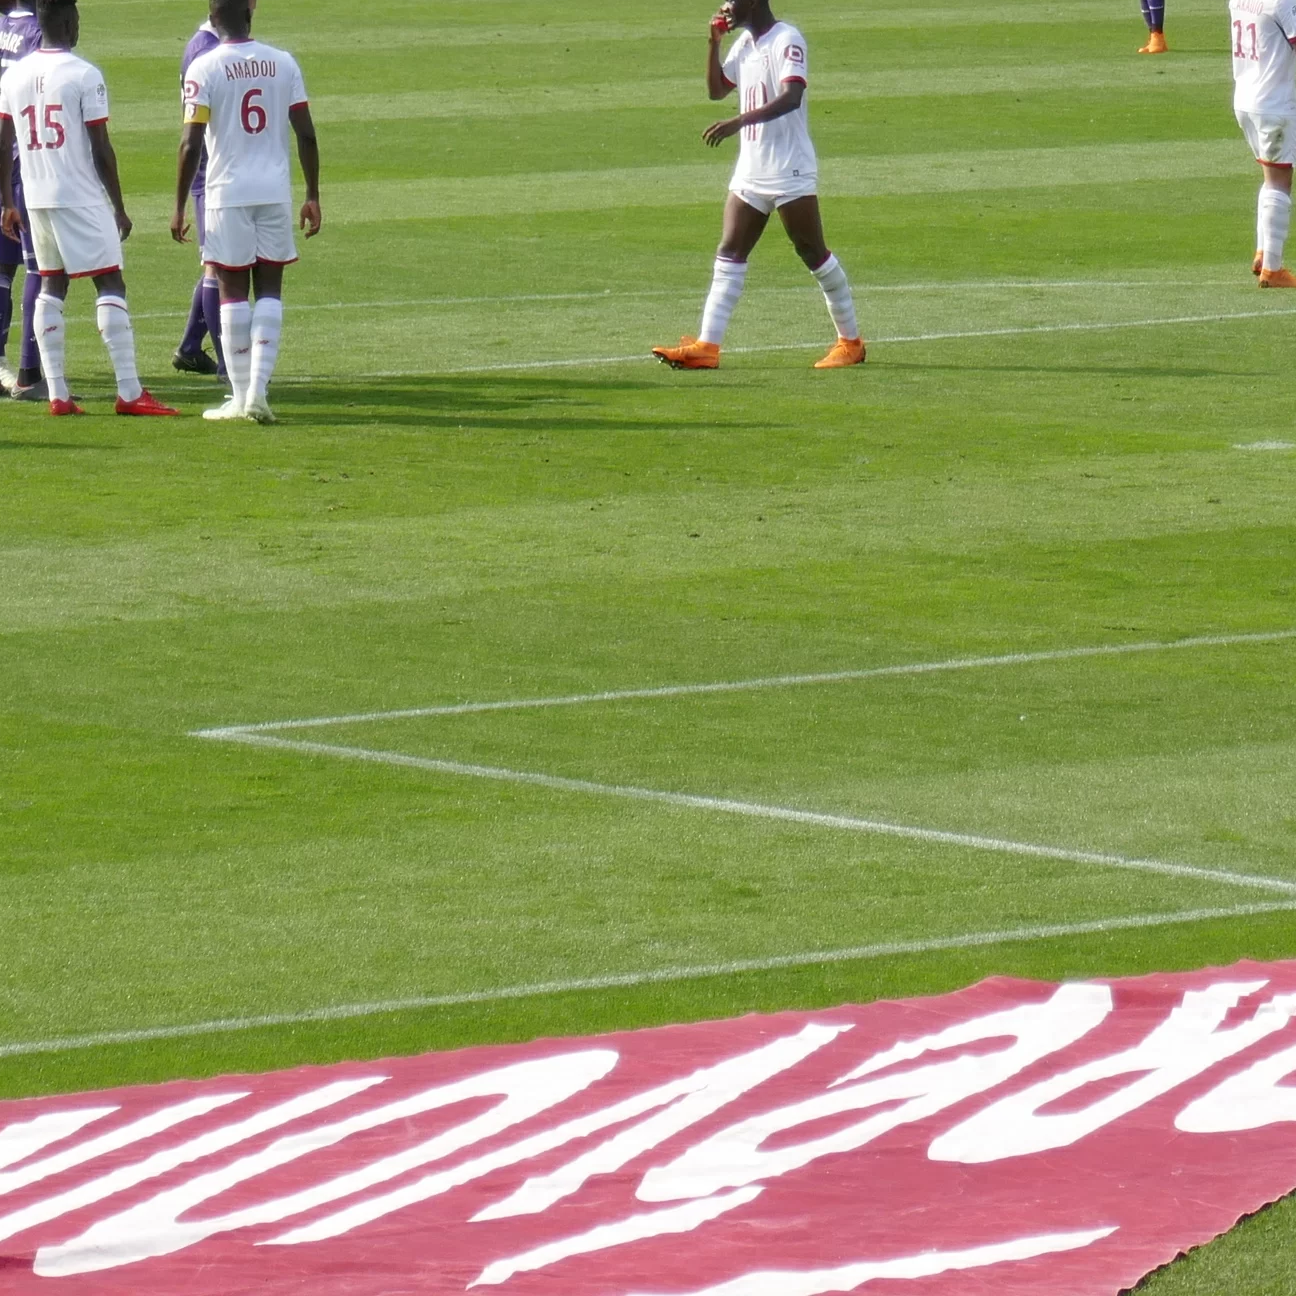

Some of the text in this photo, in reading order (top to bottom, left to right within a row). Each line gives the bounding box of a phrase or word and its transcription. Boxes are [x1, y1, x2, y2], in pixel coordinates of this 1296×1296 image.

[1233, 19, 1258, 61] 11
[35, 76, 45, 94] IE
[224, 59, 276, 82] AMADOU
[20, 104, 65, 150] 15
[241, 88, 267, 135] 6
